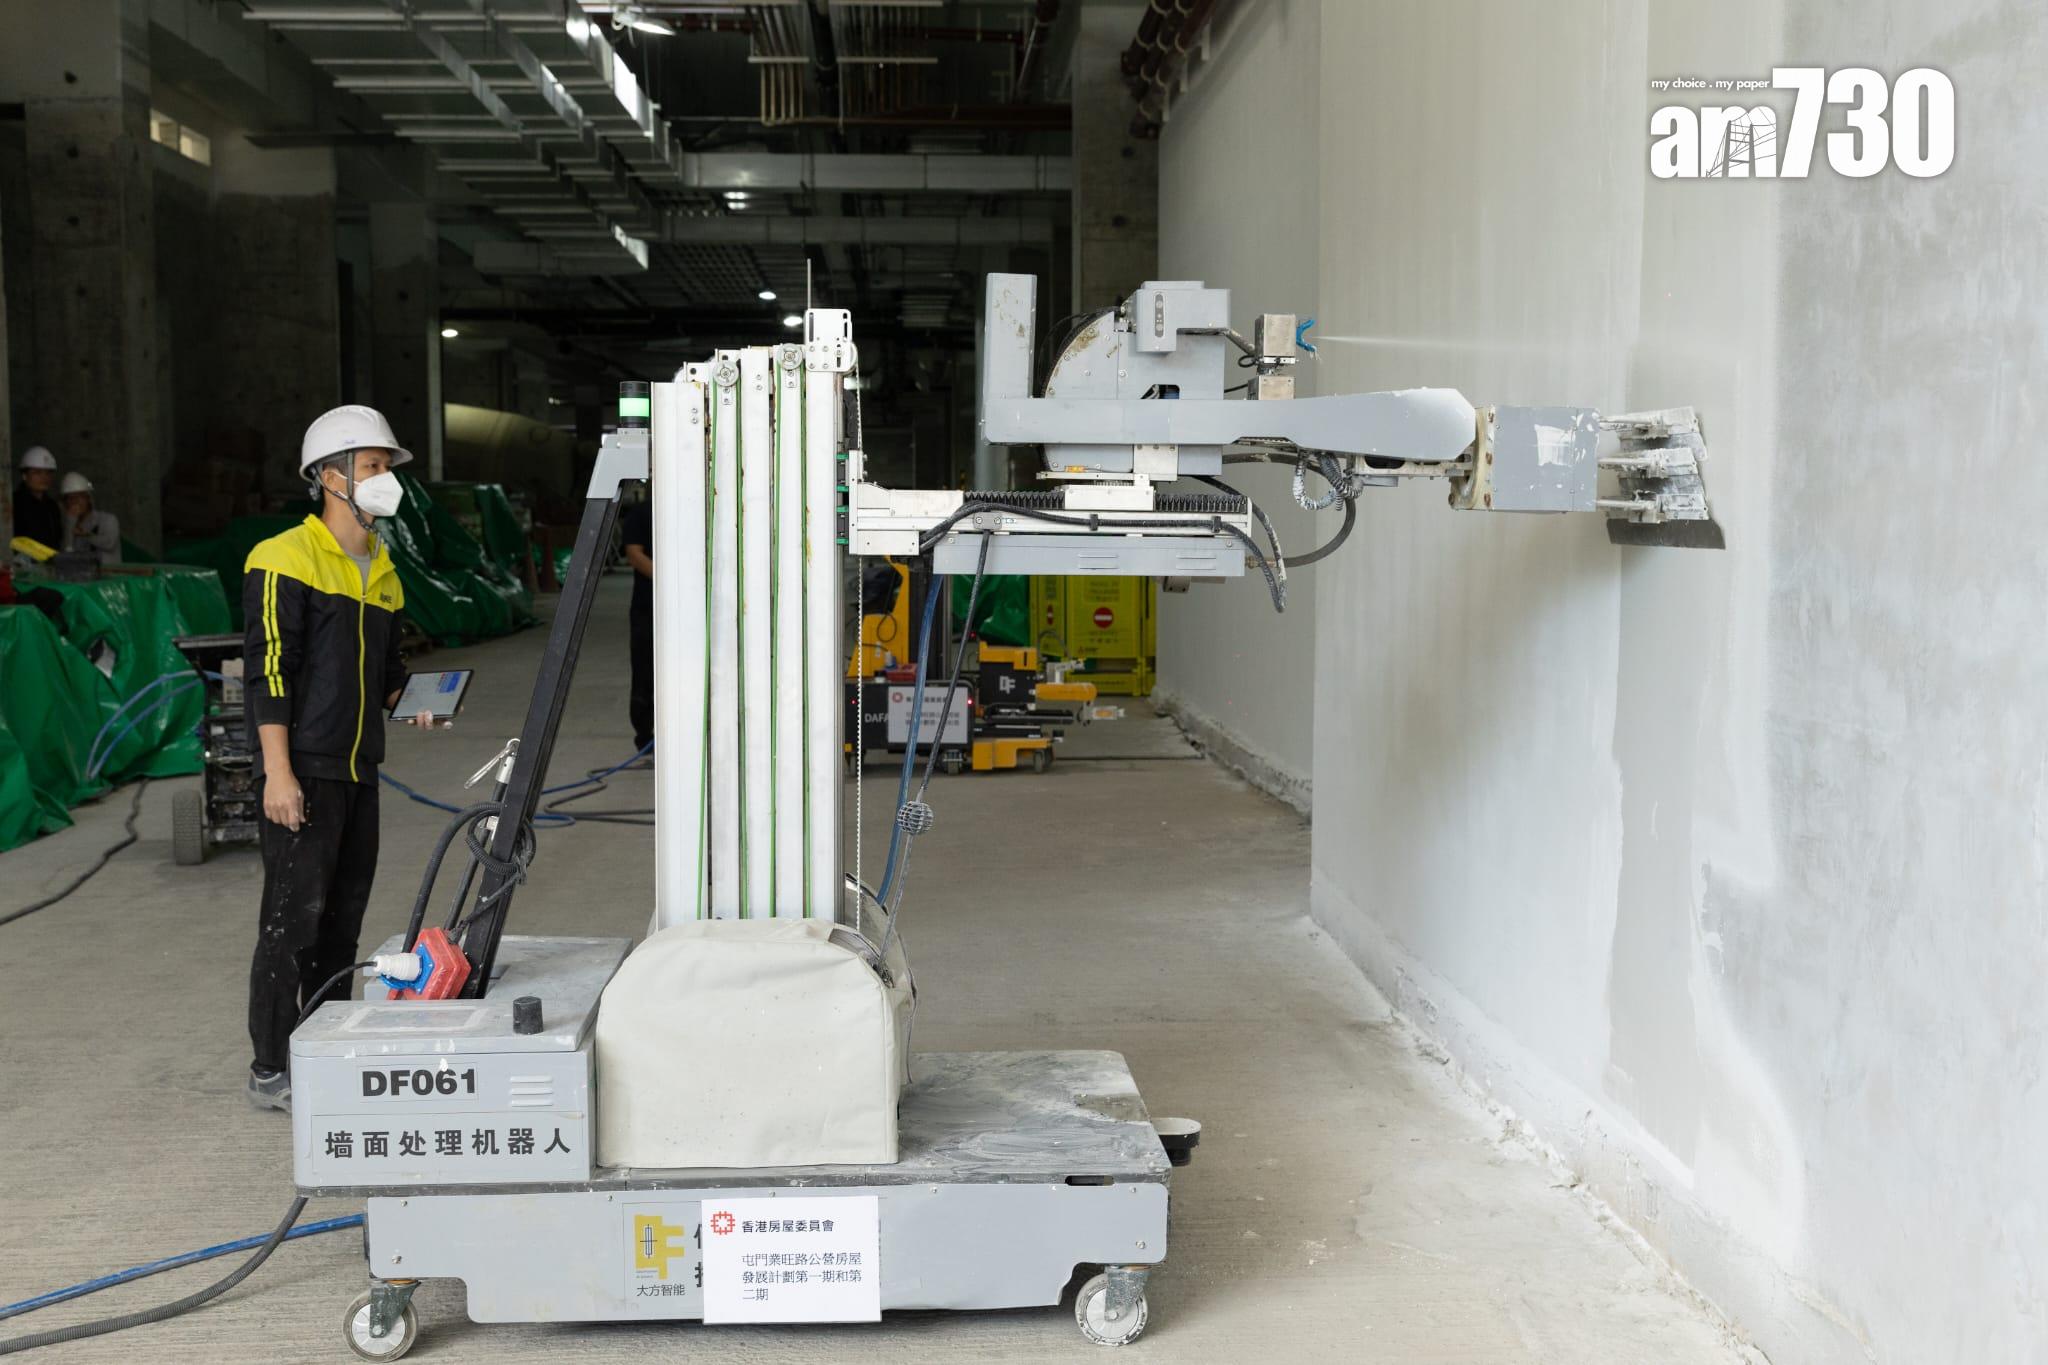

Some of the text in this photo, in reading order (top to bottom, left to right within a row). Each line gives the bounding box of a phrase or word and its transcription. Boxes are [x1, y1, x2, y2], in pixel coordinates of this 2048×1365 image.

[361, 1068, 476, 1097] DF061
[325, 1127, 571, 1159] 墙面处理机器人
[741, 1219, 835, 1233] 香港房屋委員會
[741, 1252, 863, 1267] 屯門業旺路公營房屋
[741, 1268, 863, 1284] 發展計劃第一期和第
[636, 1283, 686, 1297] 大方智能
[742, 1287, 769, 1301] 二期
